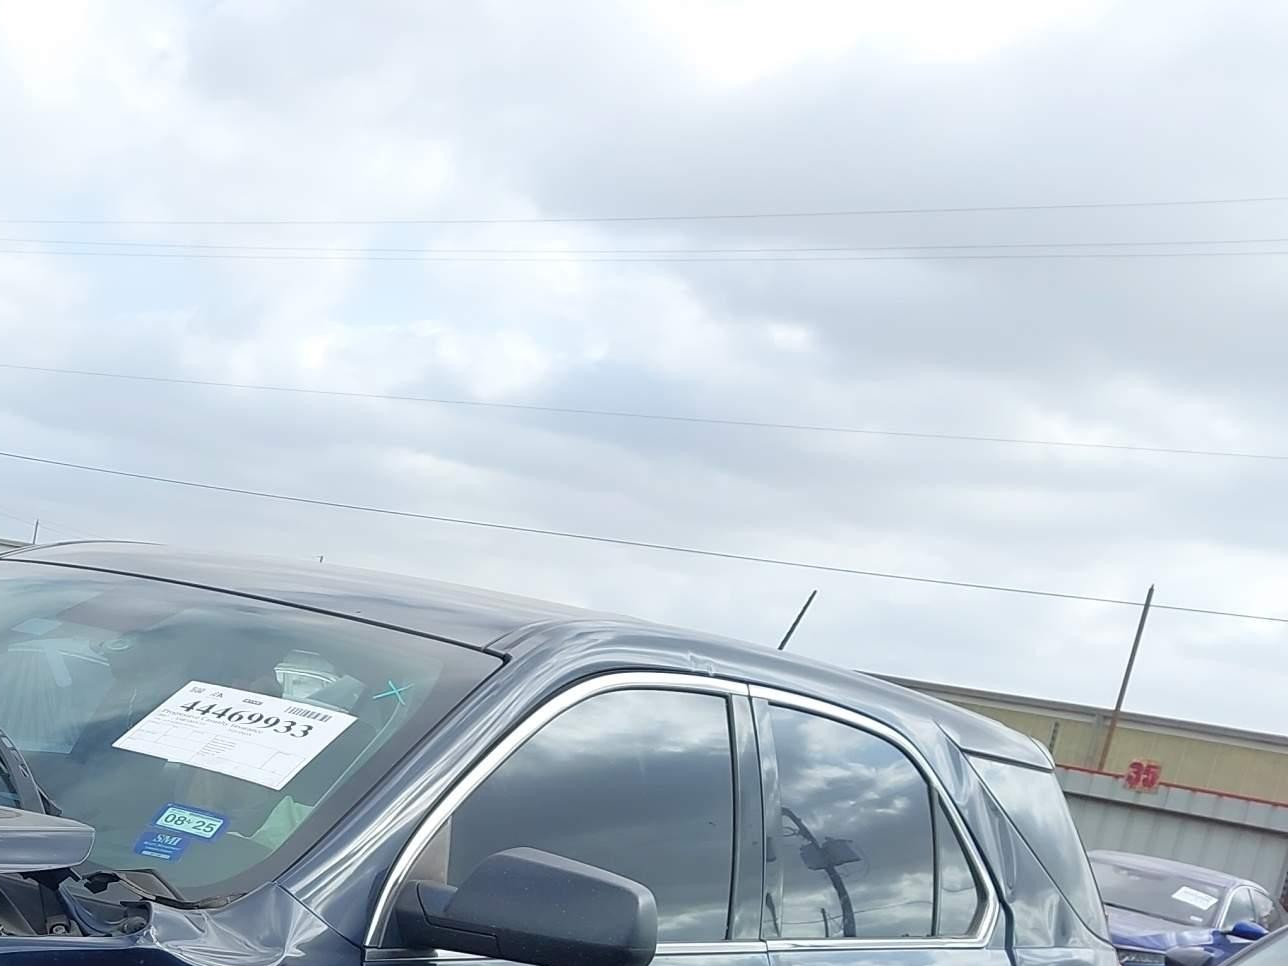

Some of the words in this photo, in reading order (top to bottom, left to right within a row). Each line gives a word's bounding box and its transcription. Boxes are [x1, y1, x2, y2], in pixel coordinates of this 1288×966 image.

[181, 700, 313, 738] 44469933
[1127, 762, 1160, 789] 35
[164, 813, 186, 826] 08
[192, 820, 217, 833] 25
[153, 834, 182, 846] SMI
